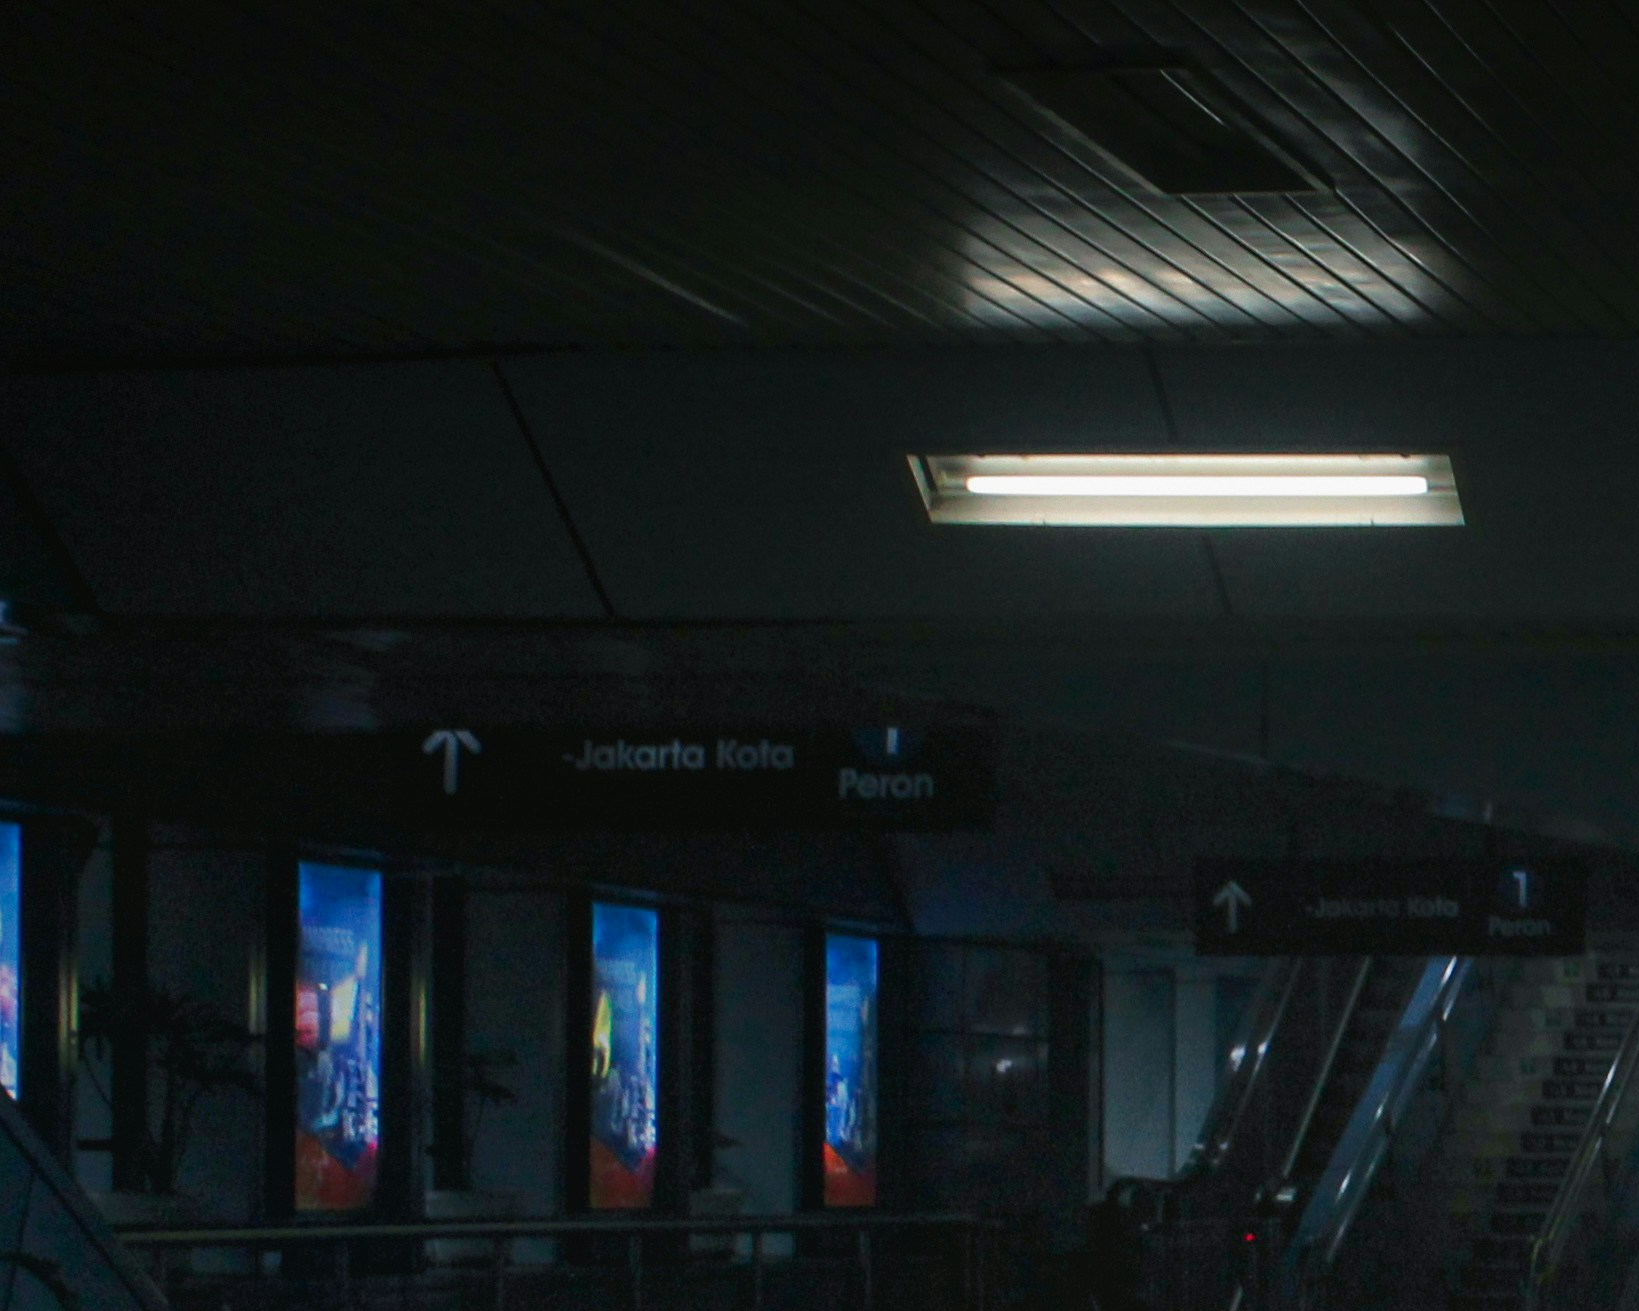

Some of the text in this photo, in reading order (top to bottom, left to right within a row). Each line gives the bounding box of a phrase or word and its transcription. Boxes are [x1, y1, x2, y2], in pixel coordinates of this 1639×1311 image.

[716, 738, 795, 771] Kota
[839, 767, 934, 800] Peron
[1512, 870, 1528, 908] 1
